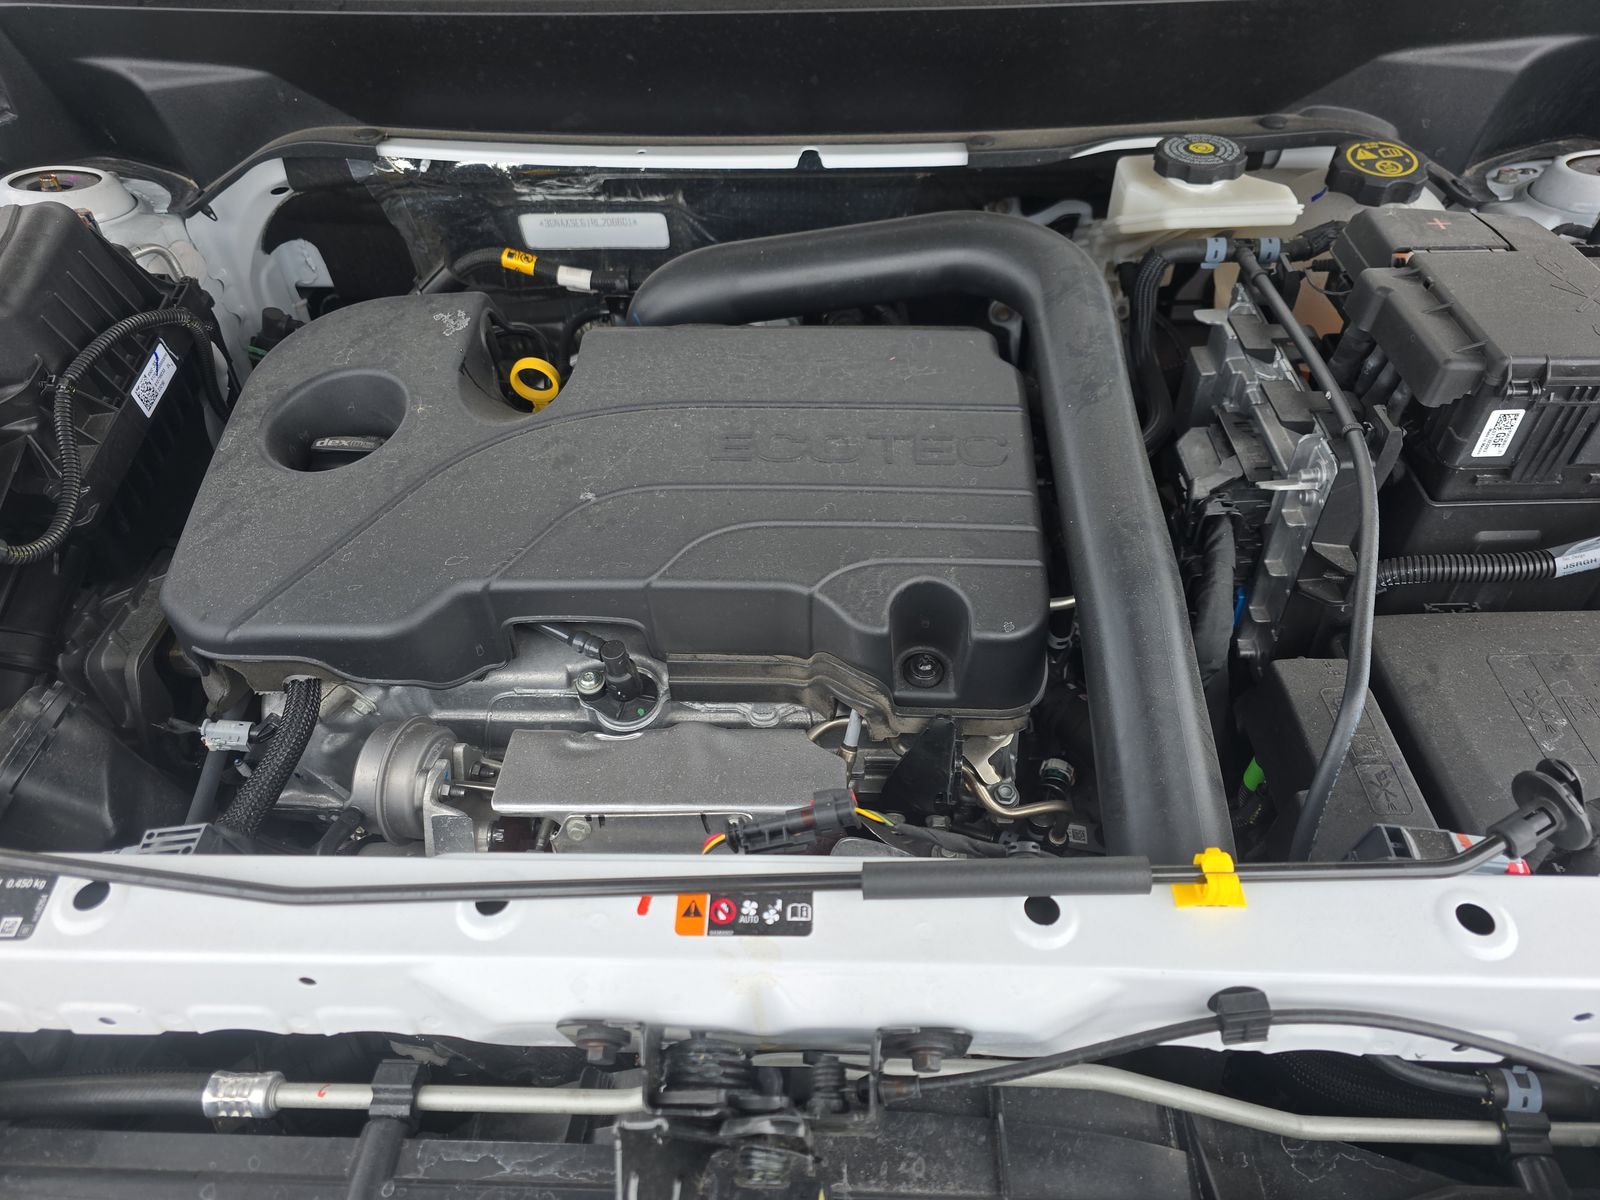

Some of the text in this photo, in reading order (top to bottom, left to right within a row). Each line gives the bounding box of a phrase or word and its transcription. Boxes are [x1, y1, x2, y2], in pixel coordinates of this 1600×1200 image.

[1492, 432, 1506, 447] G5F
[711, 432, 1008, 467] ECOTEC
[6, 878, 33, 889] 0.450
[33, 878, 47, 890] kg
[738, 916, 760, 924] AUTO
